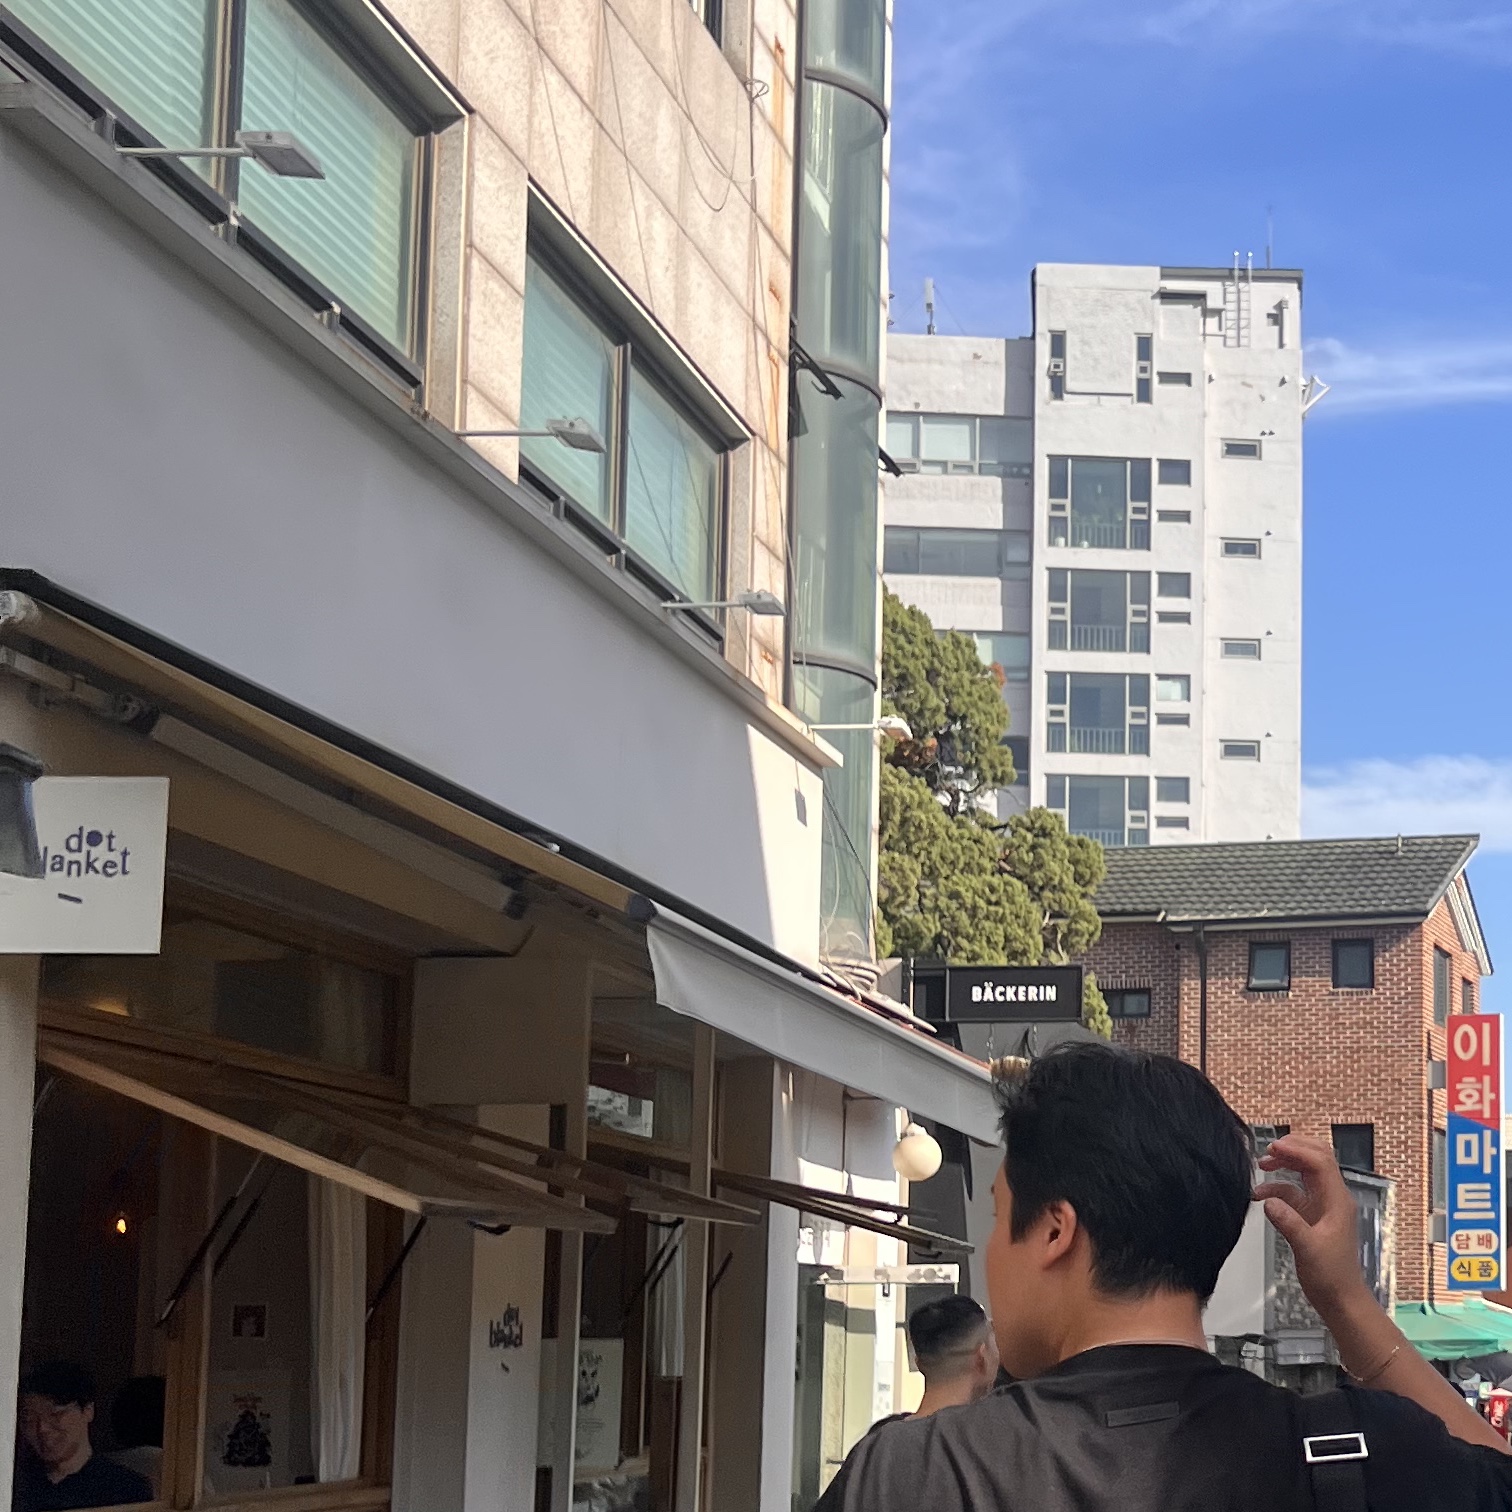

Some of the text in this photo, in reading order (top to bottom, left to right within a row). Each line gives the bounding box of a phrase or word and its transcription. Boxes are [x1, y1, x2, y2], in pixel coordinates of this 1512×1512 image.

[42, 846, 131, 878] lanket
[971, 981, 1057, 1002] BÄCKERIN
[1453, 1022, 1497, 1220] 이화마트
[1455, 1233, 1493, 1250] 담배
[1456, 1260, 1494, 1278] 식품
